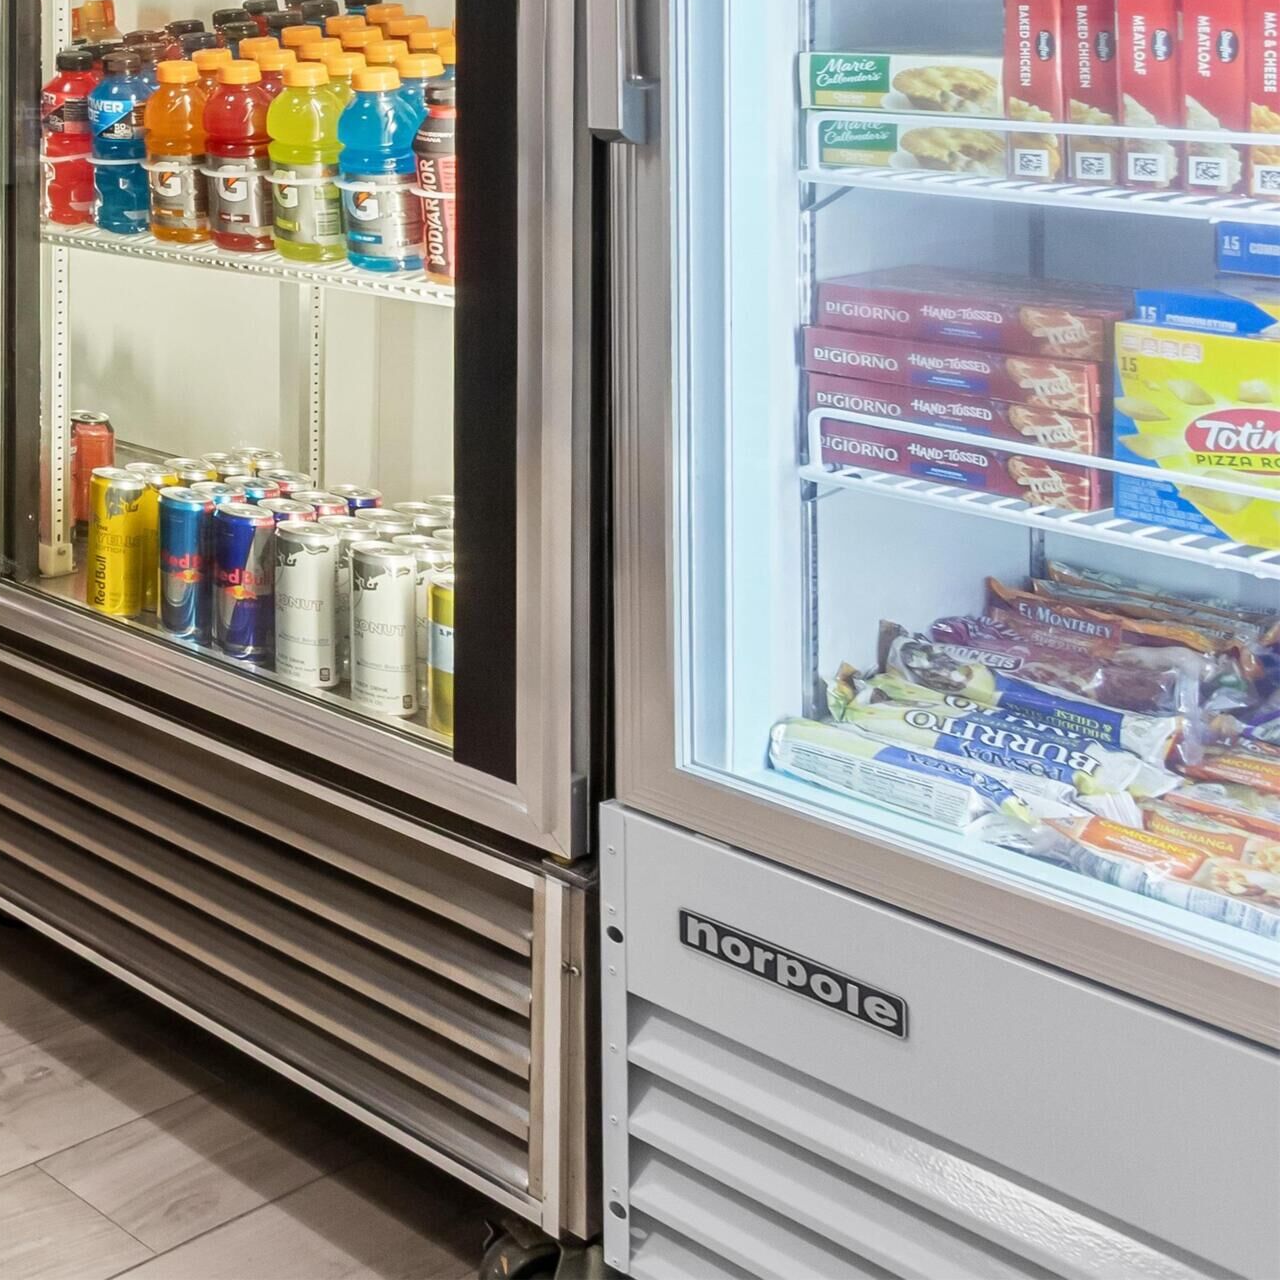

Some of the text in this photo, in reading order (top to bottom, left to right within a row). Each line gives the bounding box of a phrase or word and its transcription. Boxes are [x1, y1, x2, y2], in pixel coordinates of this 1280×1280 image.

[1264, 12, 1277, 38] MAC
[1019, 5, 1031, 86] BAKED CHICKEN
[1076, 5, 1090, 88] BAKED CHICKEN
[1133, 15, 1146, 75] MEATLOAF
[1197, 15, 1210, 78] MEATLOAF
[817, 58, 876, 74] Marie
[1264, 49, 1277, 93] CHEESE
[1224, 235, 1240, 250] 15
[826, 302, 1003, 324] DIGIORNO HAND-TOSSED
[1140, 306, 1157, 321] 15
[814, 348, 990, 374] DIGIORNO HAND-TOSSED
[1121, 356, 1137, 372] 15
[817, 392, 992, 421] DIGIORNO HAND-TOSSED
[906, 443, 988, 467] HAND-TOSSED
[1196, 454, 1252, 468] PIZZA
[95, 556, 106, 605] Red Bull
[1019, 602, 1113, 639] EL MONTEREY
[904, 709, 1101, 776] BURRITO
[686, 914, 899, 1029] norpole
